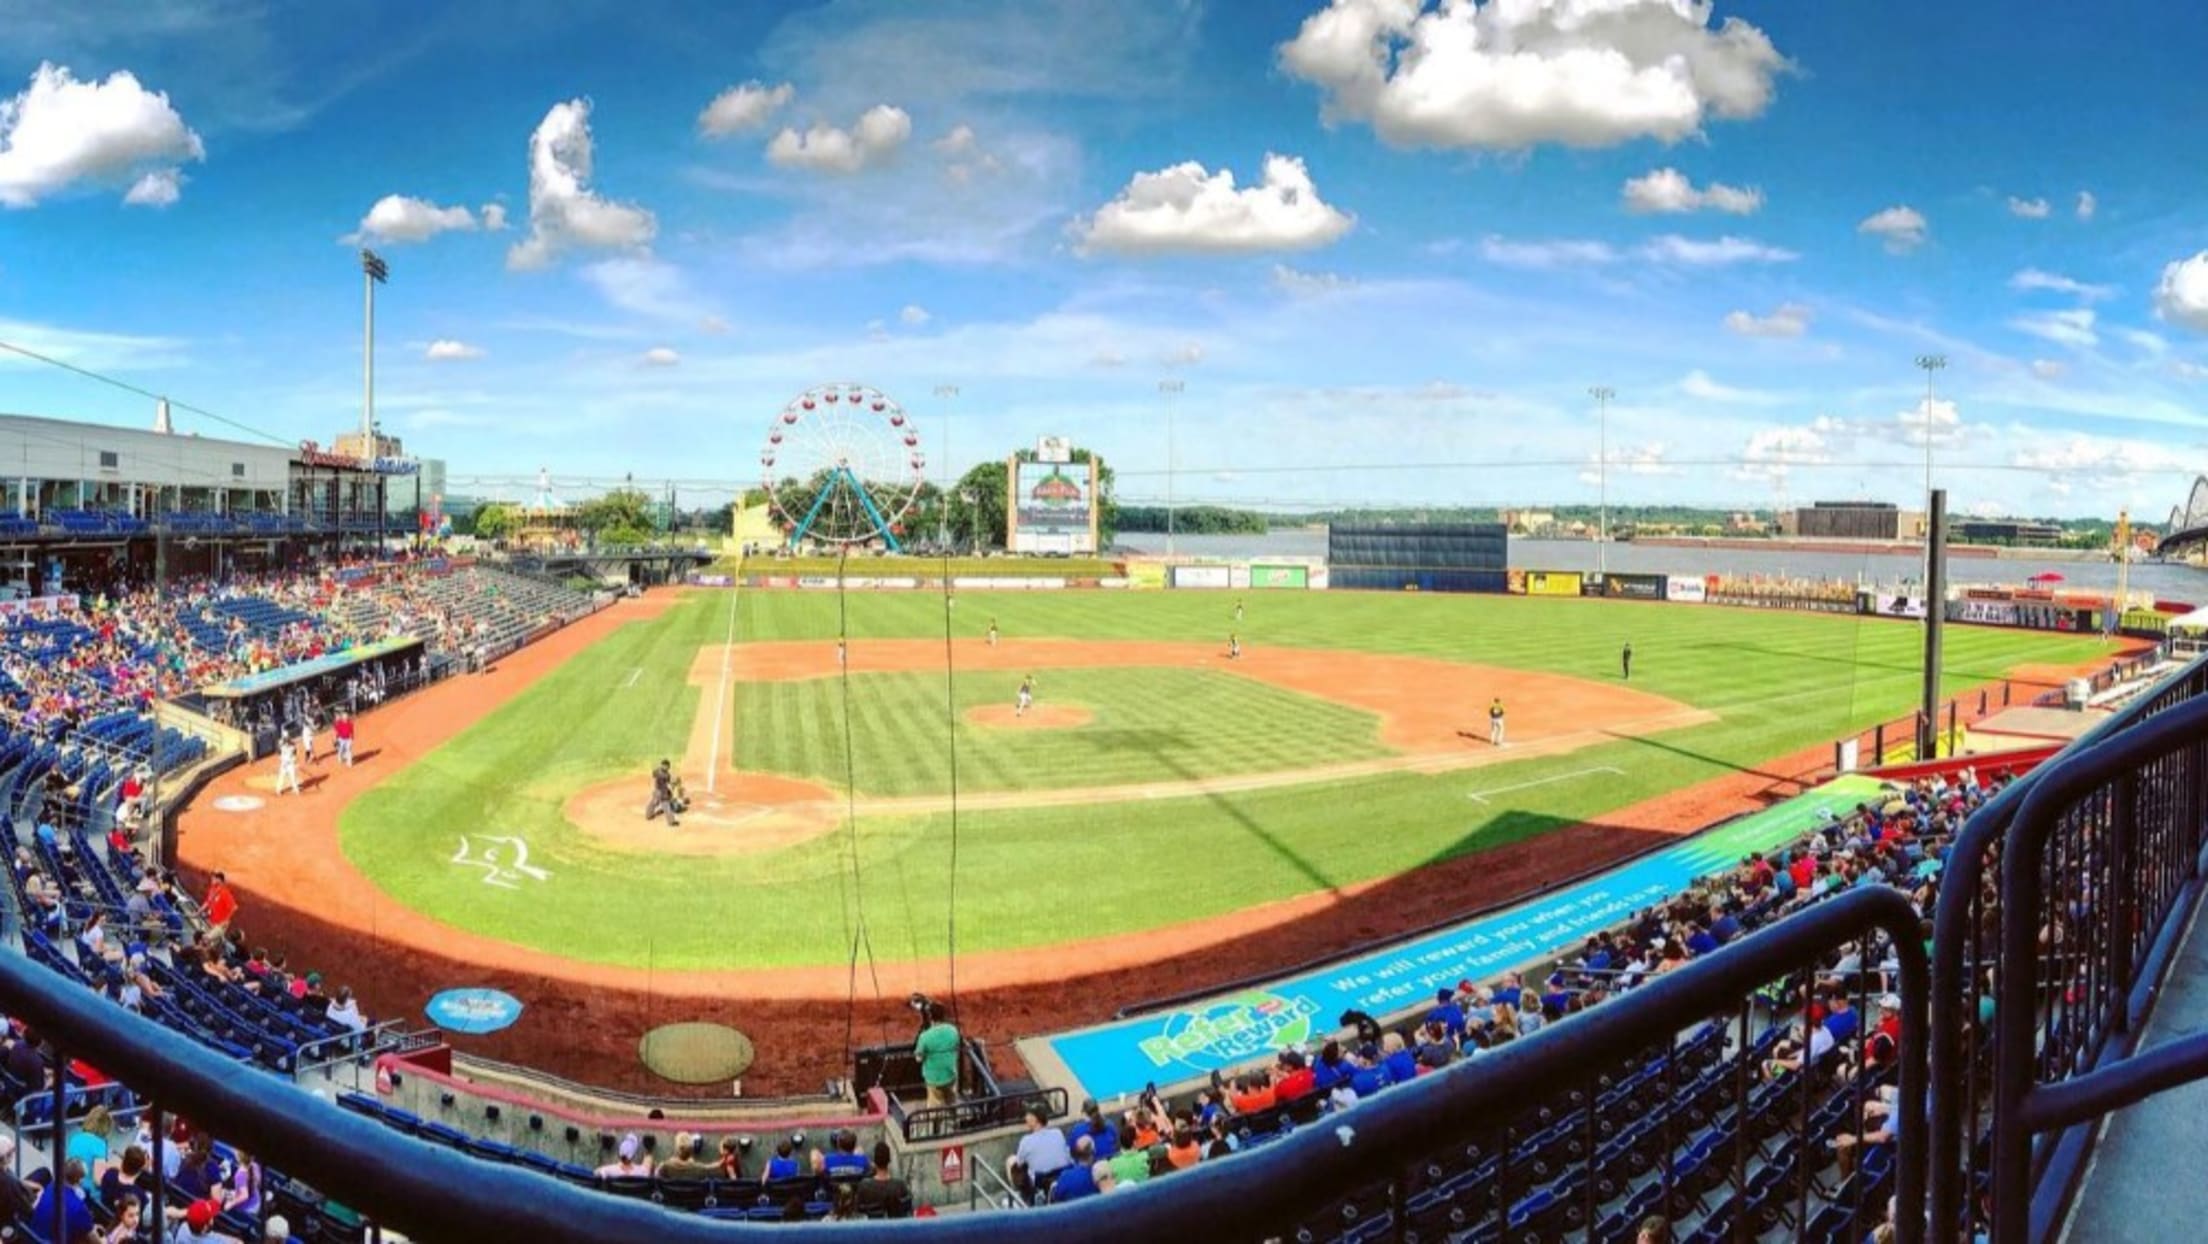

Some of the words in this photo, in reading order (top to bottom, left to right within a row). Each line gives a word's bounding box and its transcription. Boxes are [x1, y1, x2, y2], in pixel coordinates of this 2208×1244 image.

[1329, 974, 1372, 992] We
[1374, 958, 1416, 979] will
[1417, 933, 1490, 965] reward
[1492, 921, 1528, 941] you
[1529, 903, 1576, 924] when
[1579, 890, 1610, 907] you
[1358, 980, 1415, 1008] refer
[1417, 962, 1468, 989] your
[1466, 938, 1536, 967] family
[1536, 922, 1573, 942] and
[1568, 900, 1630, 928] friends
[1624, 890, 1646, 903] to
[1138, 1006, 1252, 1067] Refer
[1213, 994, 1321, 1060] Reward
